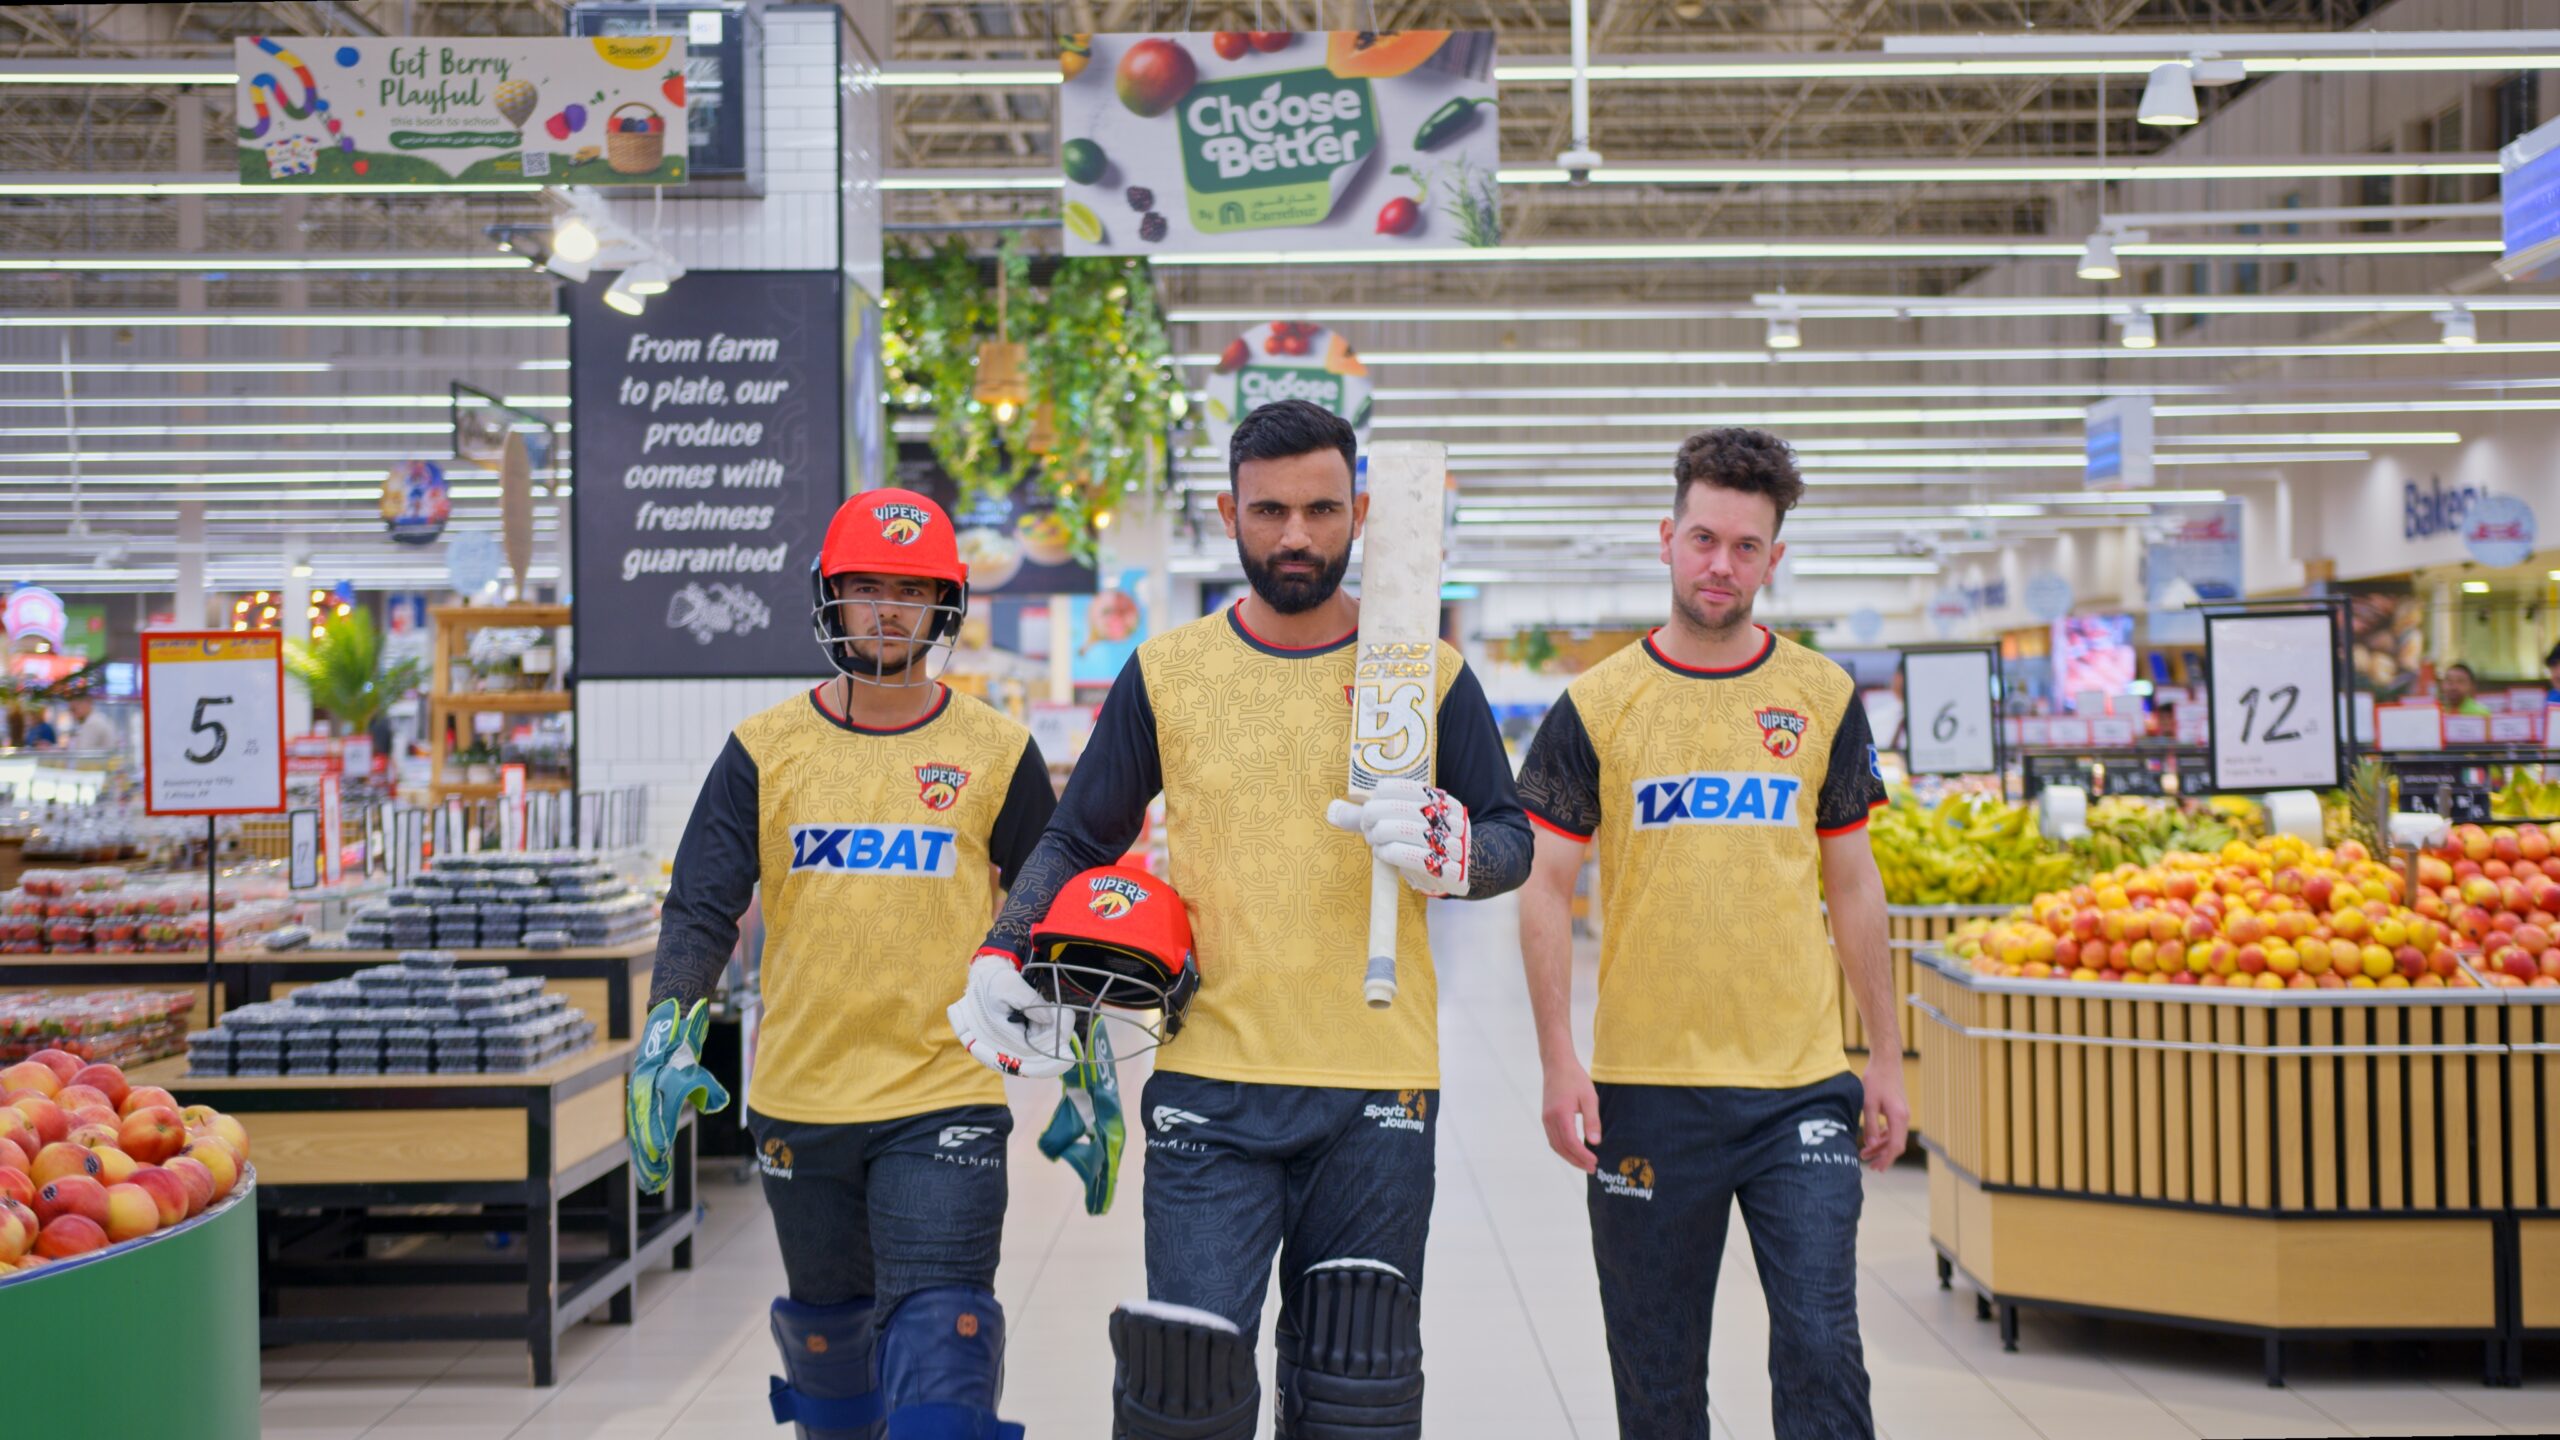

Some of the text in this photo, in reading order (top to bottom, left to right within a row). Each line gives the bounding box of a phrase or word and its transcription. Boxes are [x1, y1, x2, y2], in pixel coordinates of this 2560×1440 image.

[389, 46, 511, 82] Get Berry
[380, 78, 485, 115] Playful
[463, 117, 500, 126] school
[1187, 88, 1362, 142] Choose
[1202, 124, 1360, 179] Better
[1252, 206, 1318, 222] Carrefour
[626, 333, 779, 363] From farm
[619, 375, 790, 412] to plate, our
[1240, 371, 1339, 400] Choose
[642, 417, 764, 455] produce
[623, 458, 785, 489] comes with
[636, 500, 775, 531] freshness
[874, 506, 930, 524] VIPERS
[621, 542, 789, 581] guaranteed
[1759, 712, 1805, 733] VIPERS
[1932, 699, 1960, 744] 6
[2239, 684, 2302, 744] 12
[184, 695, 234, 765] 5
[918, 767, 967, 787] VIPERS
[1637, 777, 1799, 825] 1XBAT
[791, 828, 954, 872] 1XBAT
[1090, 878, 1149, 901] VIPERS
[1363, 1104, 1406, 1119] Sportz
[1379, 1116, 1425, 1134] Journey
[761, 1165, 793, 1181] ourney
[934, 1153, 1001, 1169] PALMFIT
[1604, 1183, 1654, 1201] Journey
